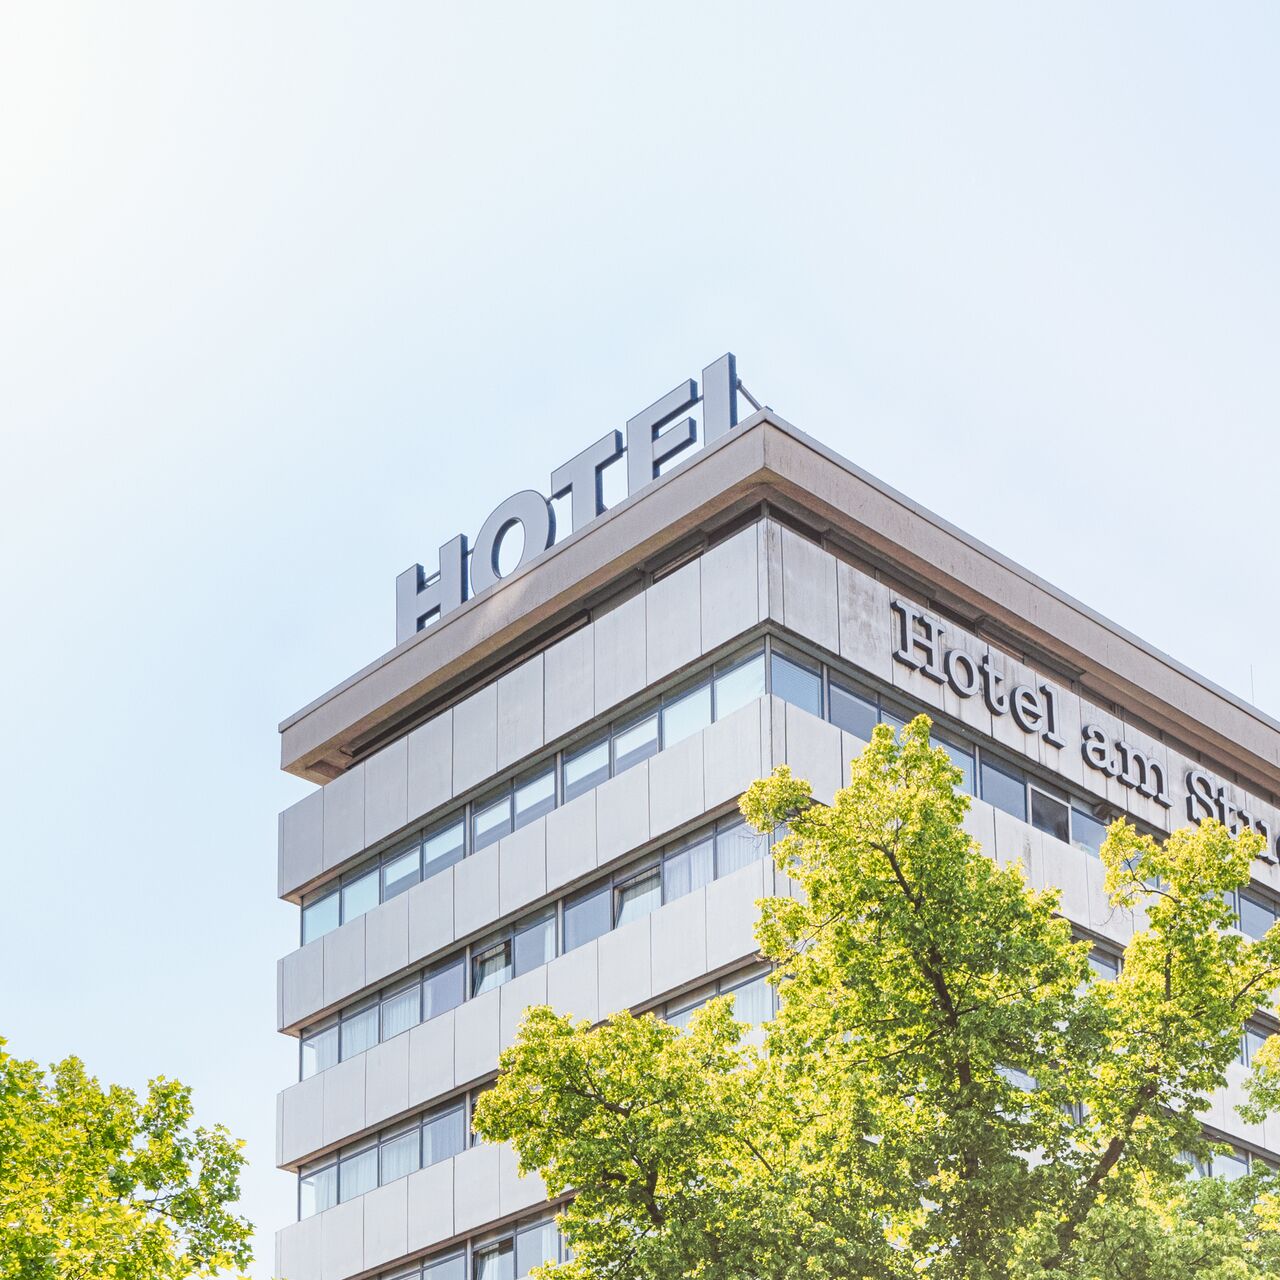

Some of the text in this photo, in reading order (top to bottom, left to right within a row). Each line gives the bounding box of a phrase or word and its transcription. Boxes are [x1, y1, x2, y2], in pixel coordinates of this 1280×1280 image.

[396, 352, 737, 648] HOTEL
[891, 599, 1068, 750] Hotel
[1081, 723, 1174, 809] am
